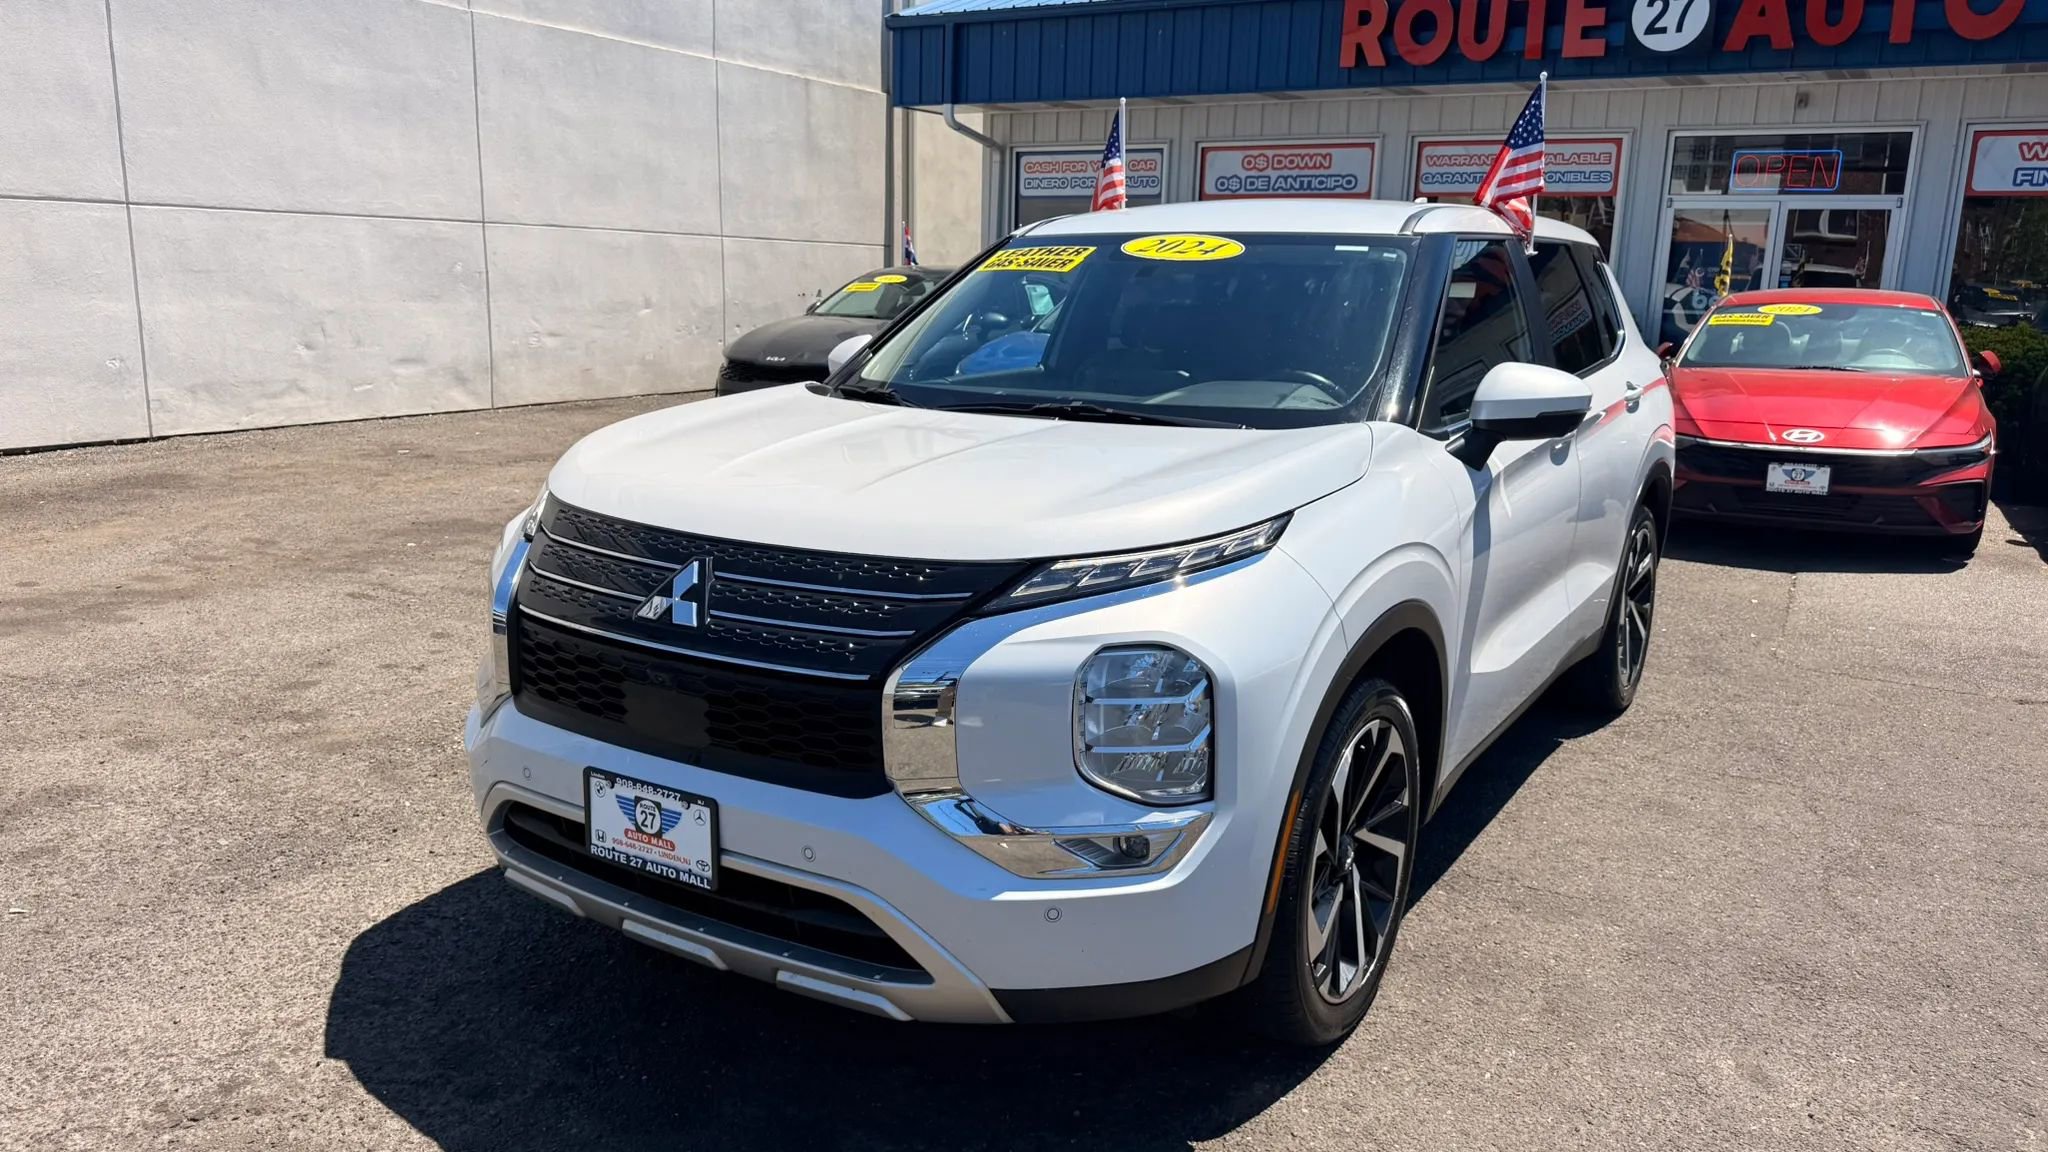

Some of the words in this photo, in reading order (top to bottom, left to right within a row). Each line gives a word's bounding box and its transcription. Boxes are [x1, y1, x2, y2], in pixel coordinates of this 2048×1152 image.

[1339, 0, 1606, 68] ROUTE
[1643, 0, 1696, 35] 27
[1024, 161, 1060, 174] CASH
[1062, 160, 1088, 173] FOR
[1128, 159, 1157, 172] CAR
[1272, 153, 1332, 170] DOWN
[1425, 153, 1497, 167] WARRAN
[1544, 152, 1612, 165] AILABLE
[1544, 170, 1612, 183] ONIBLES
[1735, 154, 1840, 188] OPEN
[1024, 177, 1069, 189] DINERO
[1070, 176, 1097, 189] POR
[1245, 175, 1270, 192] DE
[1271, 174, 1358, 191] ANTICIPO
[996, 247, 1091, 259] LEATHER
[1134, 238, 1232, 256] 2024
[616, 777, 681, 801] 908-648-2727
[640, 802, 657, 813] ROUTE
[640, 810, 657, 830] 27
[627, 830, 649, 843] AUTO
[651, 837, 674, 850] MALL
[591, 845, 628, 865] ROUTE
[629, 855, 644, 870] 27
[646, 861, 677, 880] AUTO
[680, 871, 712, 890] MALL
